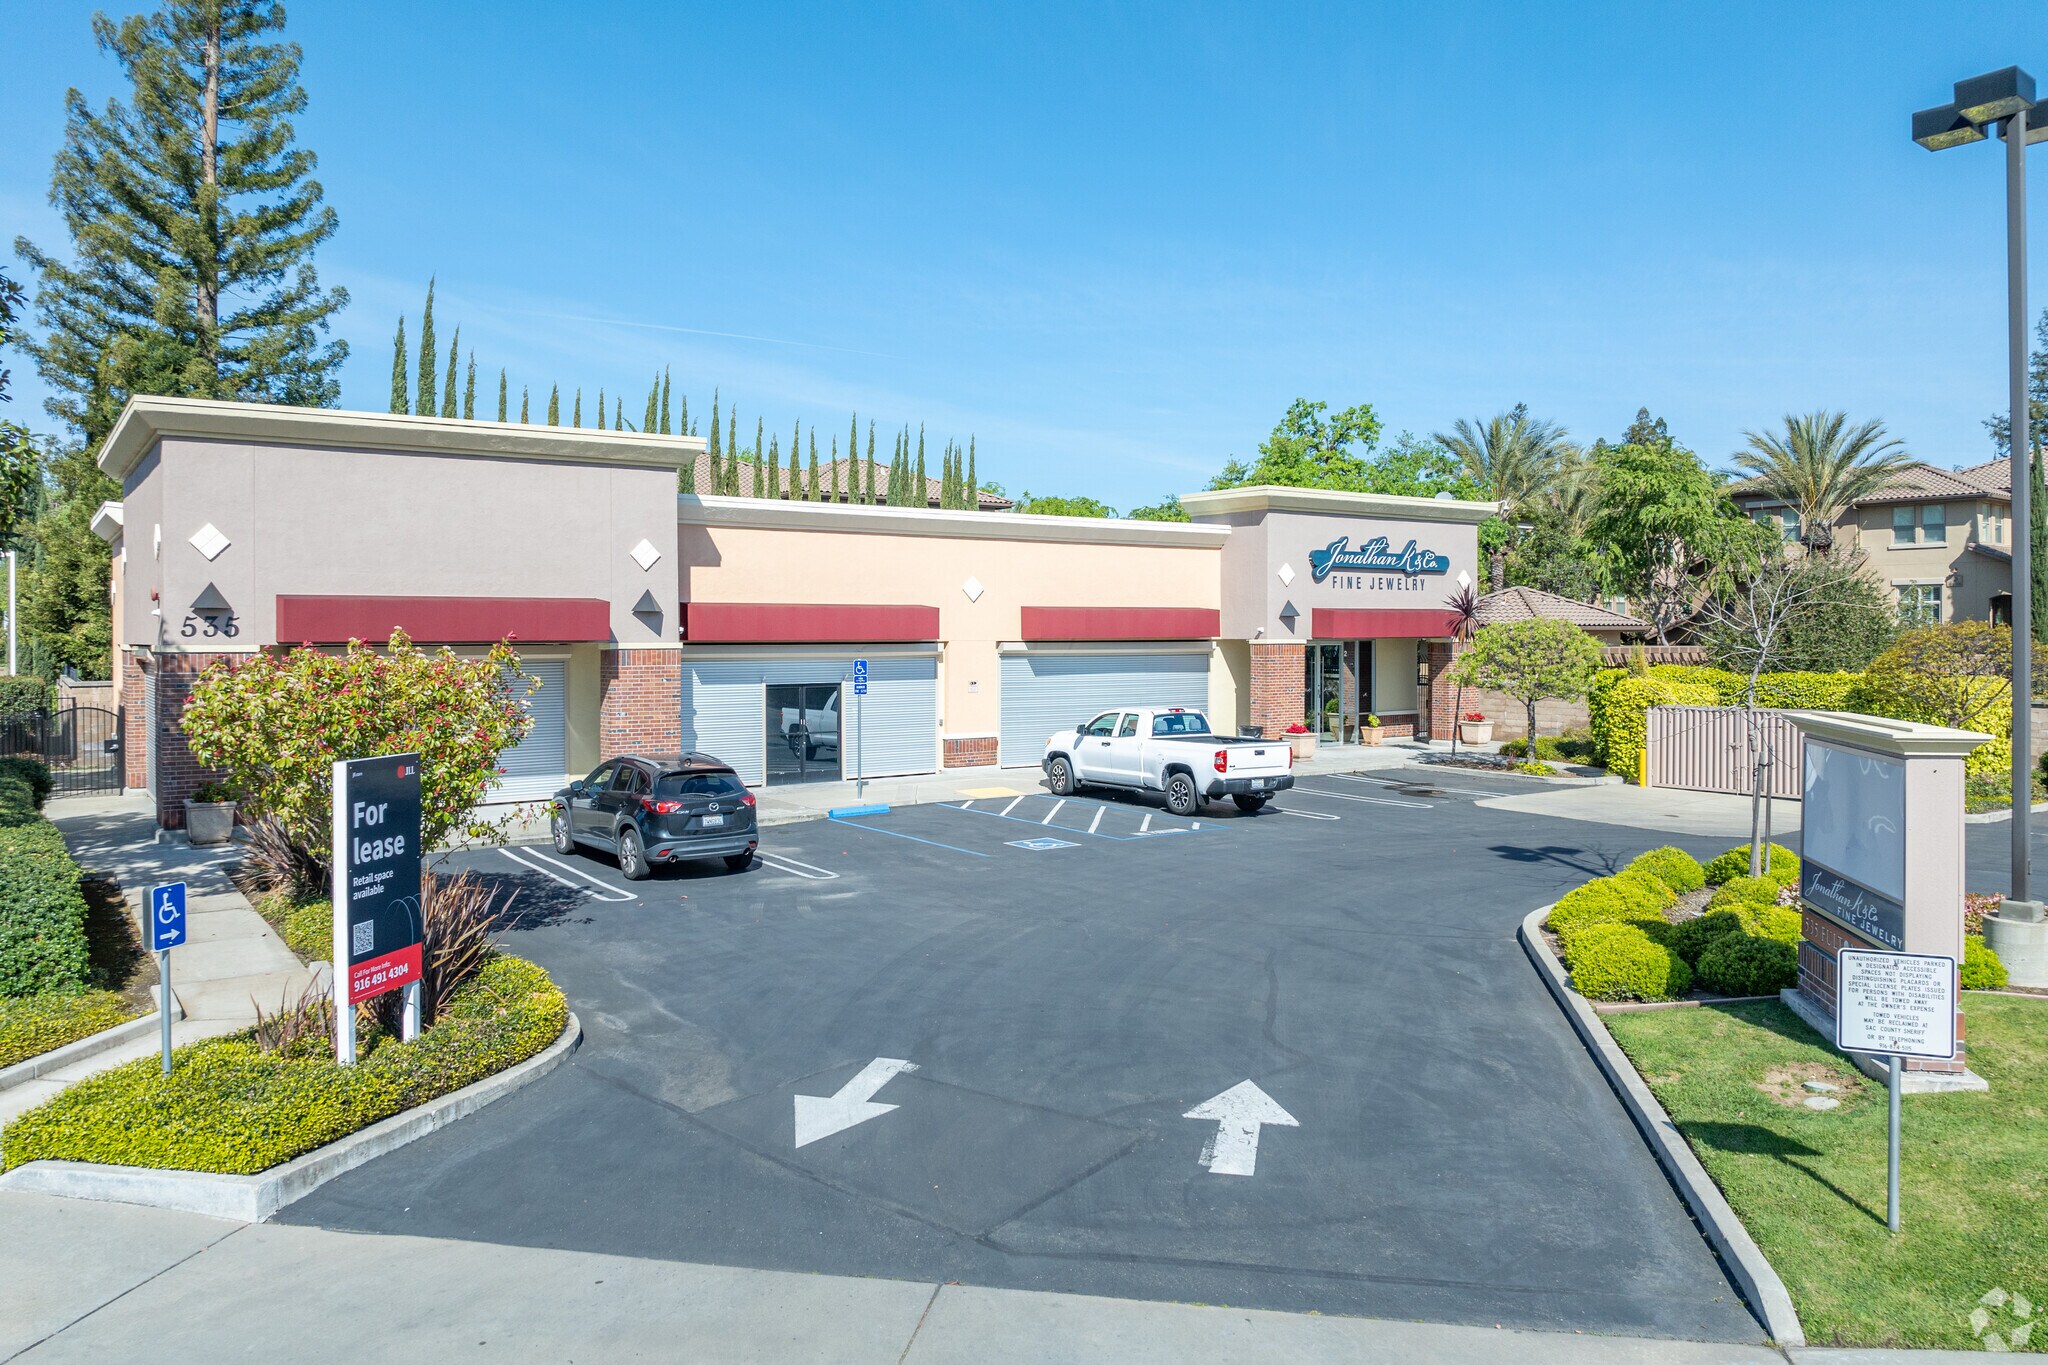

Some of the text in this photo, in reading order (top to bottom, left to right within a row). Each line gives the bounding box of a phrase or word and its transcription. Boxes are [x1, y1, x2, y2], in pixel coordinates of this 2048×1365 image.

[1316, 538, 1400, 576] Jonathan
[1333, 576, 1425, 591] FINE JEWELRY
[181, 616, 240, 637] 535
[405, 766, 415, 775] JLL
[354, 802, 388, 828] For
[354, 835, 405, 865] lease
[353, 870, 394, 887] Retail space
[353, 884, 384, 900] available
[1805, 872, 1852, 907] Jonathan
[1838, 907, 1902, 949] FINE JEWELRY
[354, 970, 362, 978] Call
[354, 963, 408, 992] 916 491 4304
[1853, 975, 1896, 983] DISTINGUISHING
[1889, 1036, 1924, 1044] TELEPHONING
